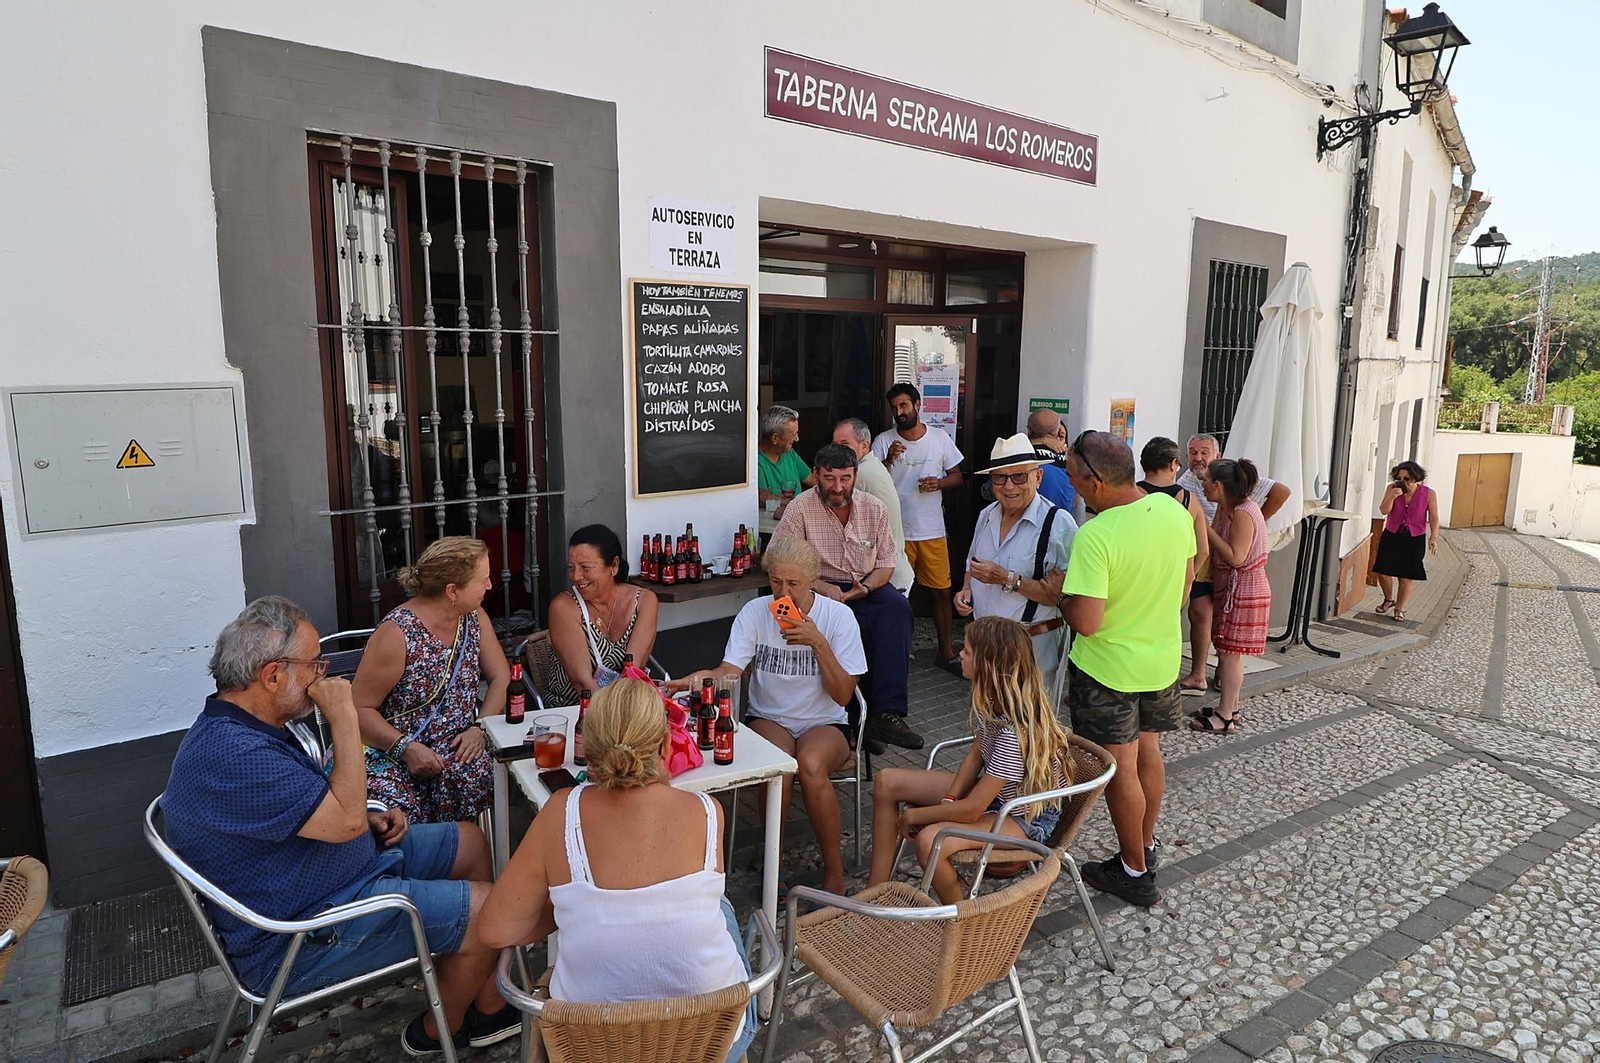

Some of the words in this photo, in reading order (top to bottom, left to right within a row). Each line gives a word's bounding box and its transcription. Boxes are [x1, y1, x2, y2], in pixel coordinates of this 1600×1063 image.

[774, 67, 878, 123] TABERNA
[887, 97, 978, 146] SERRANA
[985, 121, 1017, 155] LOS
[1020, 130, 1093, 172] ROMEROS
[651, 207, 735, 229] AUTOSERVICIO
[687, 231, 702, 245] EN
[668, 247, 721, 269] TERRAZA
[641, 285, 661, 296] HOY
[703, 288, 744, 300] TENEMOS
[641, 302, 711, 317] ENSALADILLA
[642, 323, 679, 337] PAPAS
[683, 320, 739, 335] ALIÑADAS
[643, 343, 692, 358] TORTILLITA
[693, 343, 743, 358] CAMARONES
[644, 362, 682, 375] CAZÓN
[688, 362, 726, 376] ADOBO
[643, 381, 689, 395] TOMATE
[697, 381, 729, 394] ROSA
[694, 400, 742, 414] PLANCHA
[645, 414, 716, 433] DISTRAÍDOS
